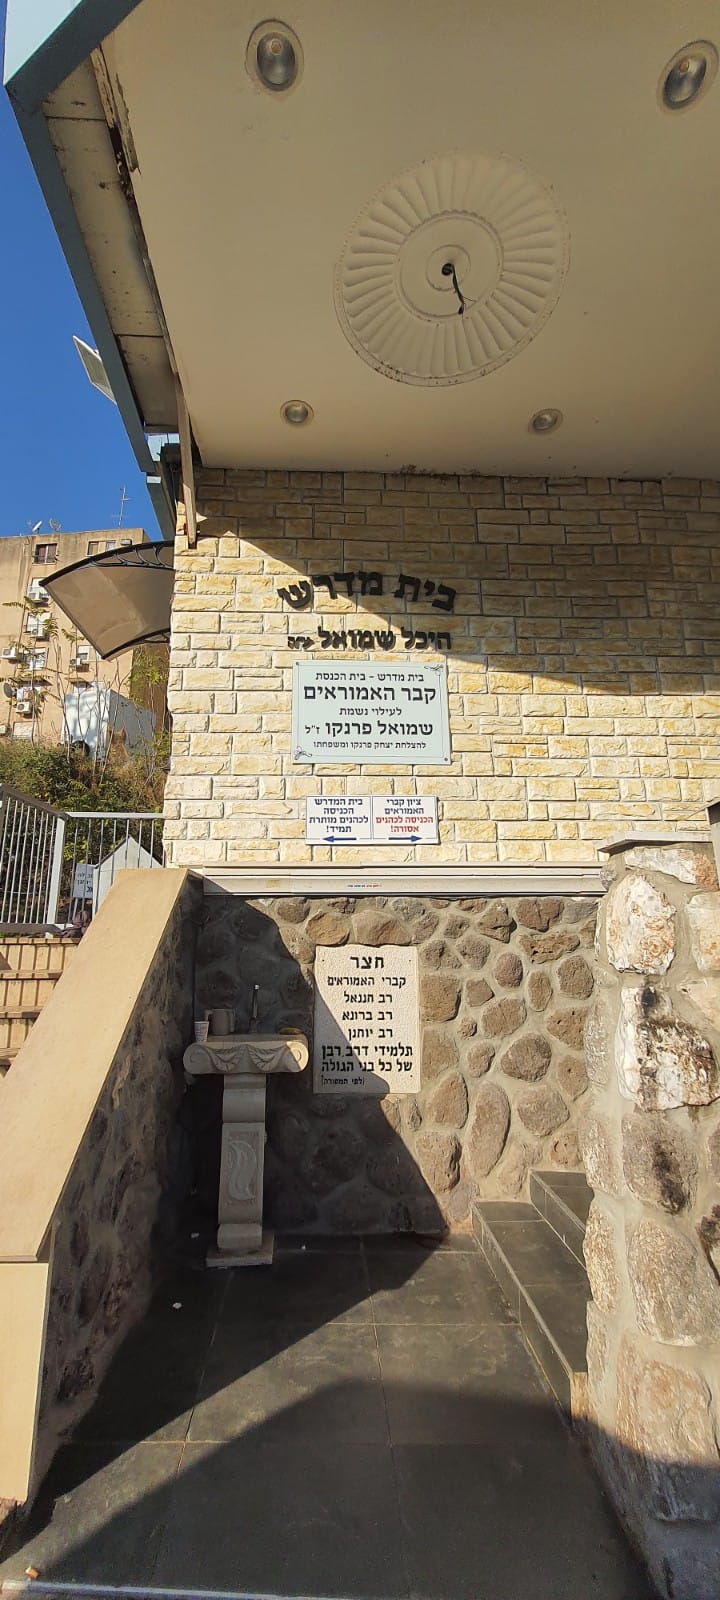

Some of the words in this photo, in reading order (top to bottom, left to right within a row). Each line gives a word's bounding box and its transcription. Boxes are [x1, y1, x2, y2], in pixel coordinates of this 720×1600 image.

[277, 571, 383, 608] מדרש
[394, 573, 456, 611] בית
[318, 626, 396, 650] שמואל
[401, 626, 451, 649] היכל
[316, 672, 346, 680] הכנסת
[304, 686, 394, 700] האמוראים
[402, 688, 435, 704] קבר
[372, 707, 401, 716] לעילוי
[305, 725, 320, 734] ז"ל
[326, 722, 372, 737] פרנקו
[378, 720, 433, 735] שמואל
[350, 957, 384, 968] חצר
[328, 977, 374, 986] האמוראים
[382, 977, 406, 988] קברי
[344, 992, 374, 1003] חננאל
[342, 1012, 372, 1021] ברונא
[348, 1029, 373, 1041] יוחנן
[378, 1029, 392, 1038] רב
[322, 1045, 341, 1060] רבן
[346, 1045, 368, 1056] דרב
[375, 1042, 412, 1056] תלמידי
[322, 1059, 354, 1071] הגולה
[359, 1062, 374, 1071] בני
[379, 1059, 392, 1071] כל
[397, 1059, 412, 1072] של
